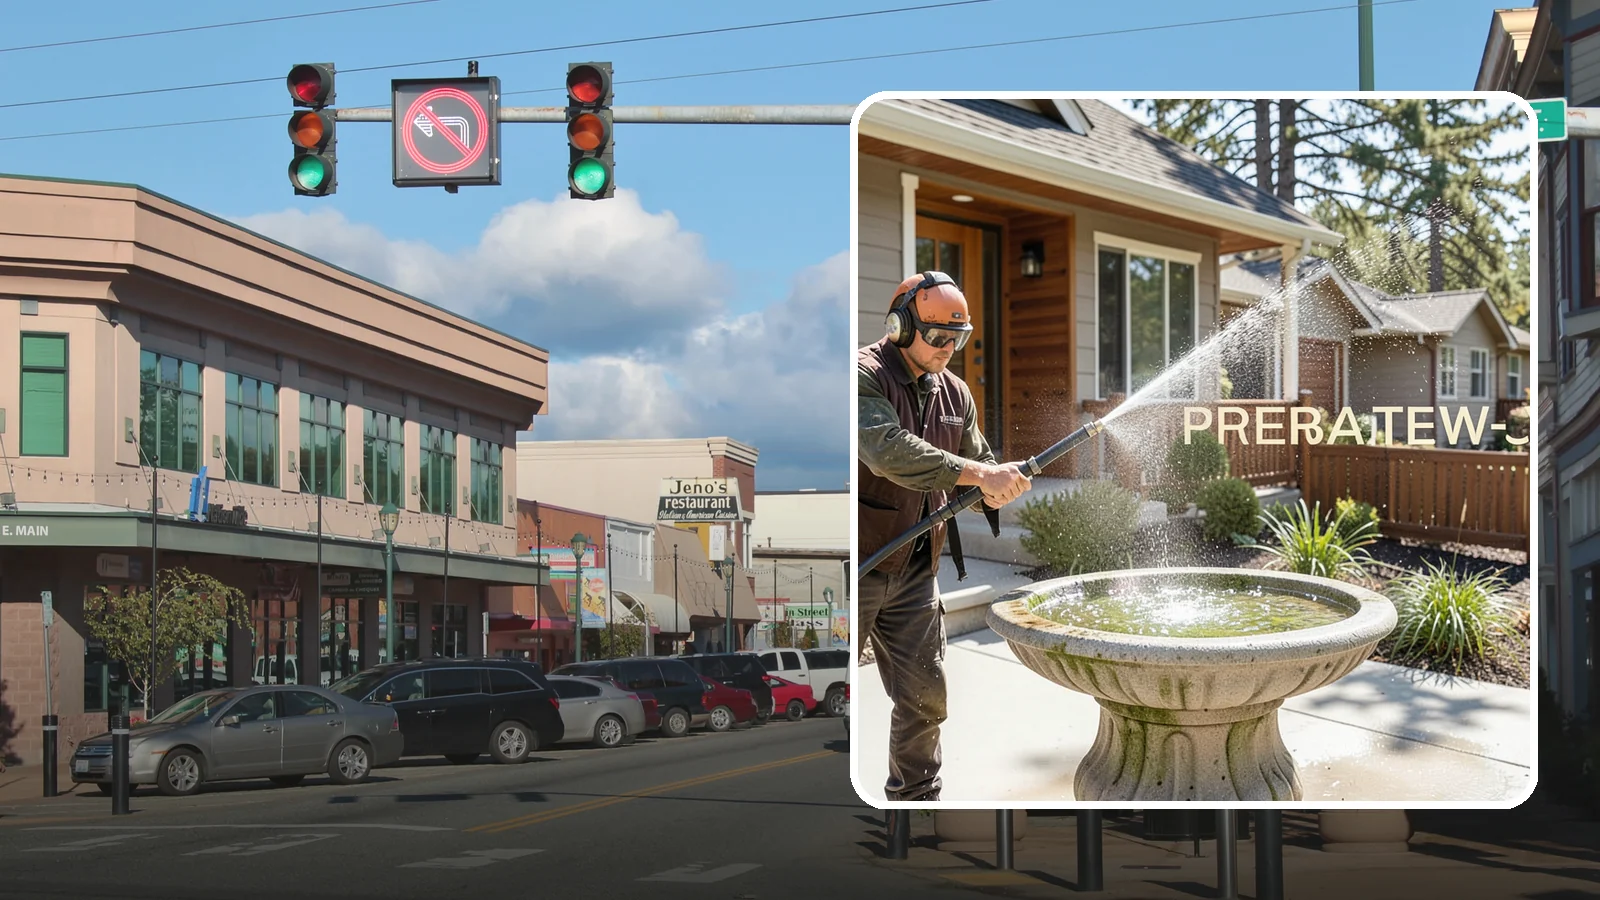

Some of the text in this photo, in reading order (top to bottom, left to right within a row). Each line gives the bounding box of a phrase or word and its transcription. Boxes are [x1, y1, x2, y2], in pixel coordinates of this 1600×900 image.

[669, 479, 728, 495] Jeno's
[665, 496, 731, 509] restaurant
[658, 509, 681, 520] Italian
[686, 509, 714, 520] American
[715, 509, 738, 520] Cuisine
[2, 525, 49, 536] E. MAIN
[786, 607, 829, 617] in Street
[790, 619, 824, 627] lass
